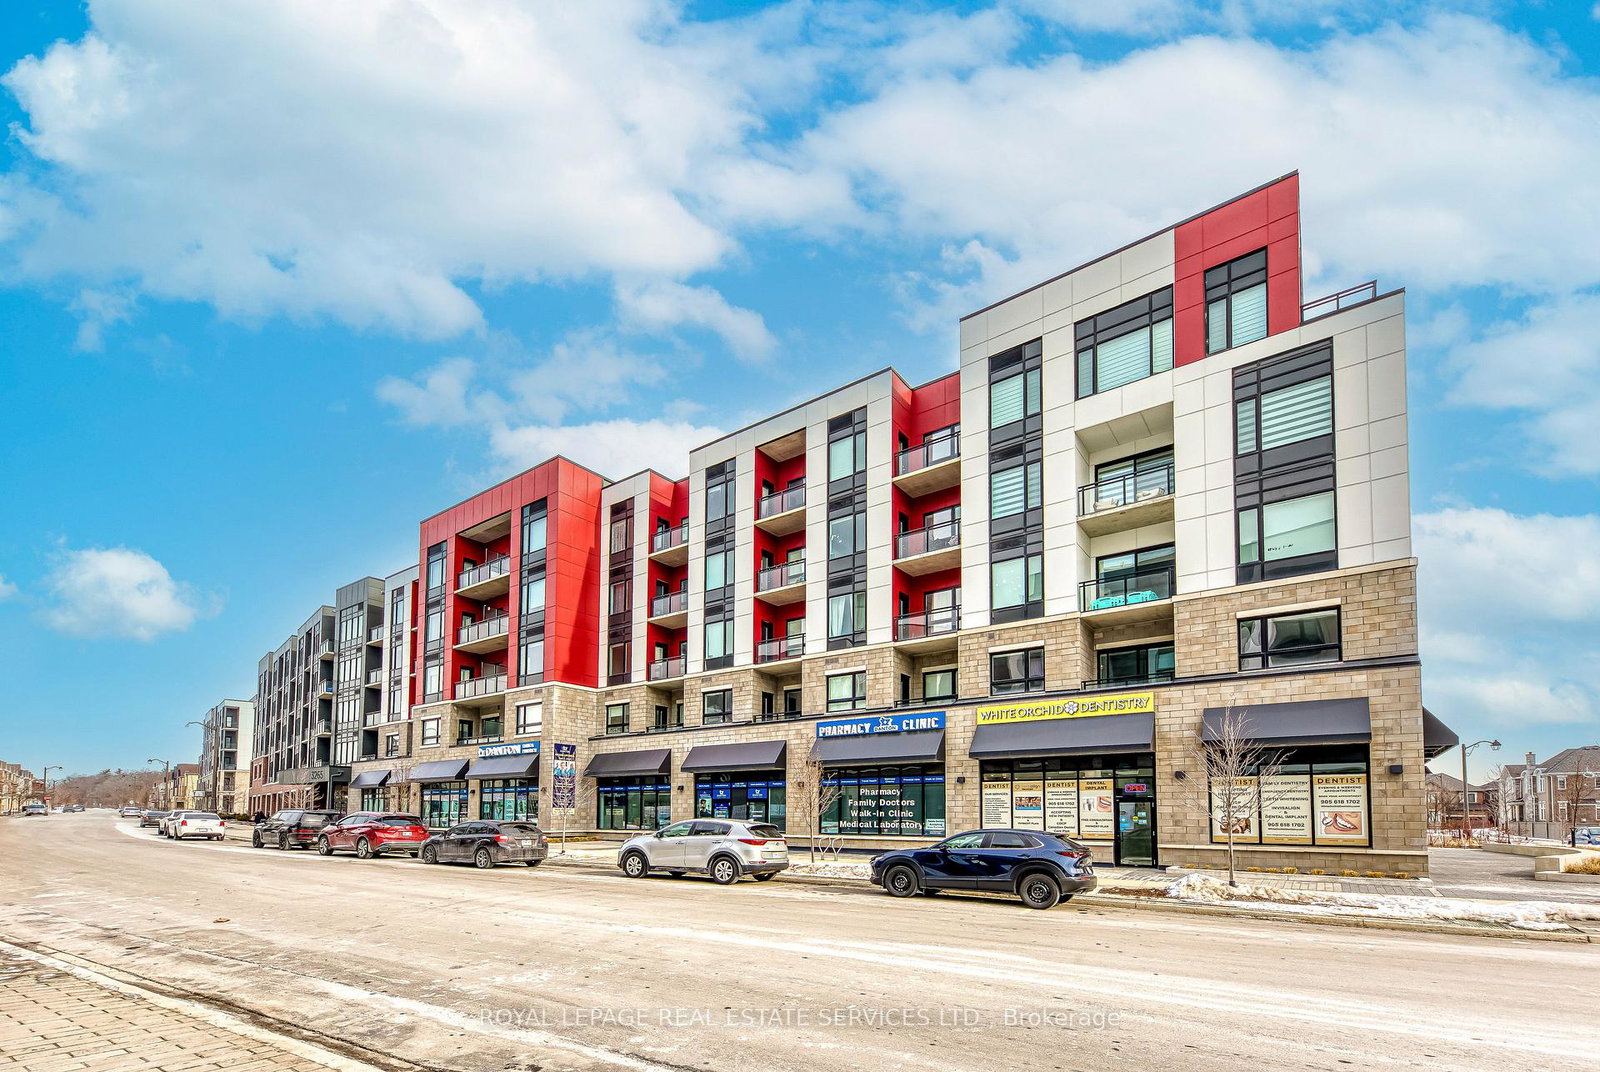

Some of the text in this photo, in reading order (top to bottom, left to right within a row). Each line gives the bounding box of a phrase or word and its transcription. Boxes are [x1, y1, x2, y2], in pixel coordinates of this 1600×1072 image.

[980, 697, 1150, 721] WHITE ORCHID DENTISTRY
[818, 717, 939, 737] PHARMACY CLINIC
[859, 788, 902, 796] Pharmacy
[848, 799, 876, 807] Family
[874, 820, 925, 830] Laboratory
